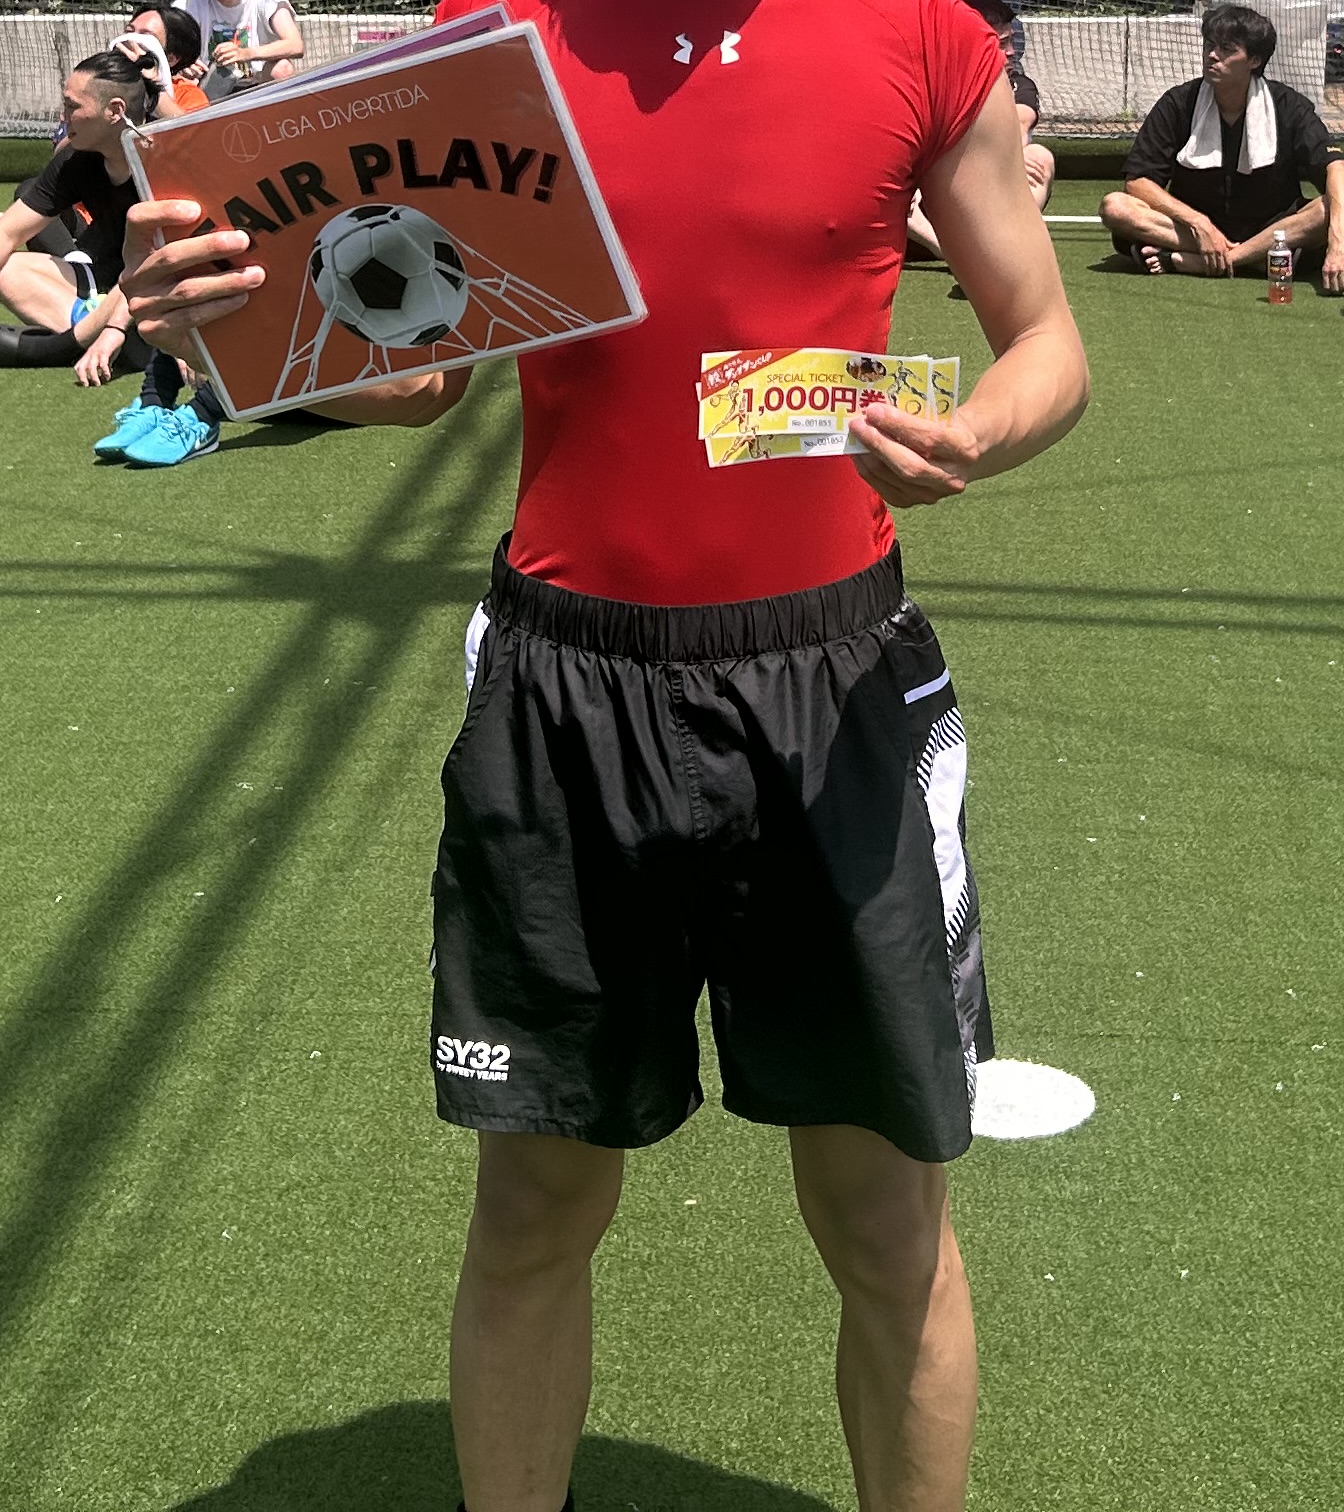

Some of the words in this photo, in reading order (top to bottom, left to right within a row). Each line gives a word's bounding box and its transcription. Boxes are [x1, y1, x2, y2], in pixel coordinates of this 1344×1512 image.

[348, 137, 561, 204] PLAY!
[767, 372, 806, 384] SPECIAL
[808, 372, 844, 384] TICKET
[437, 1036, 510, 1070] SY32
